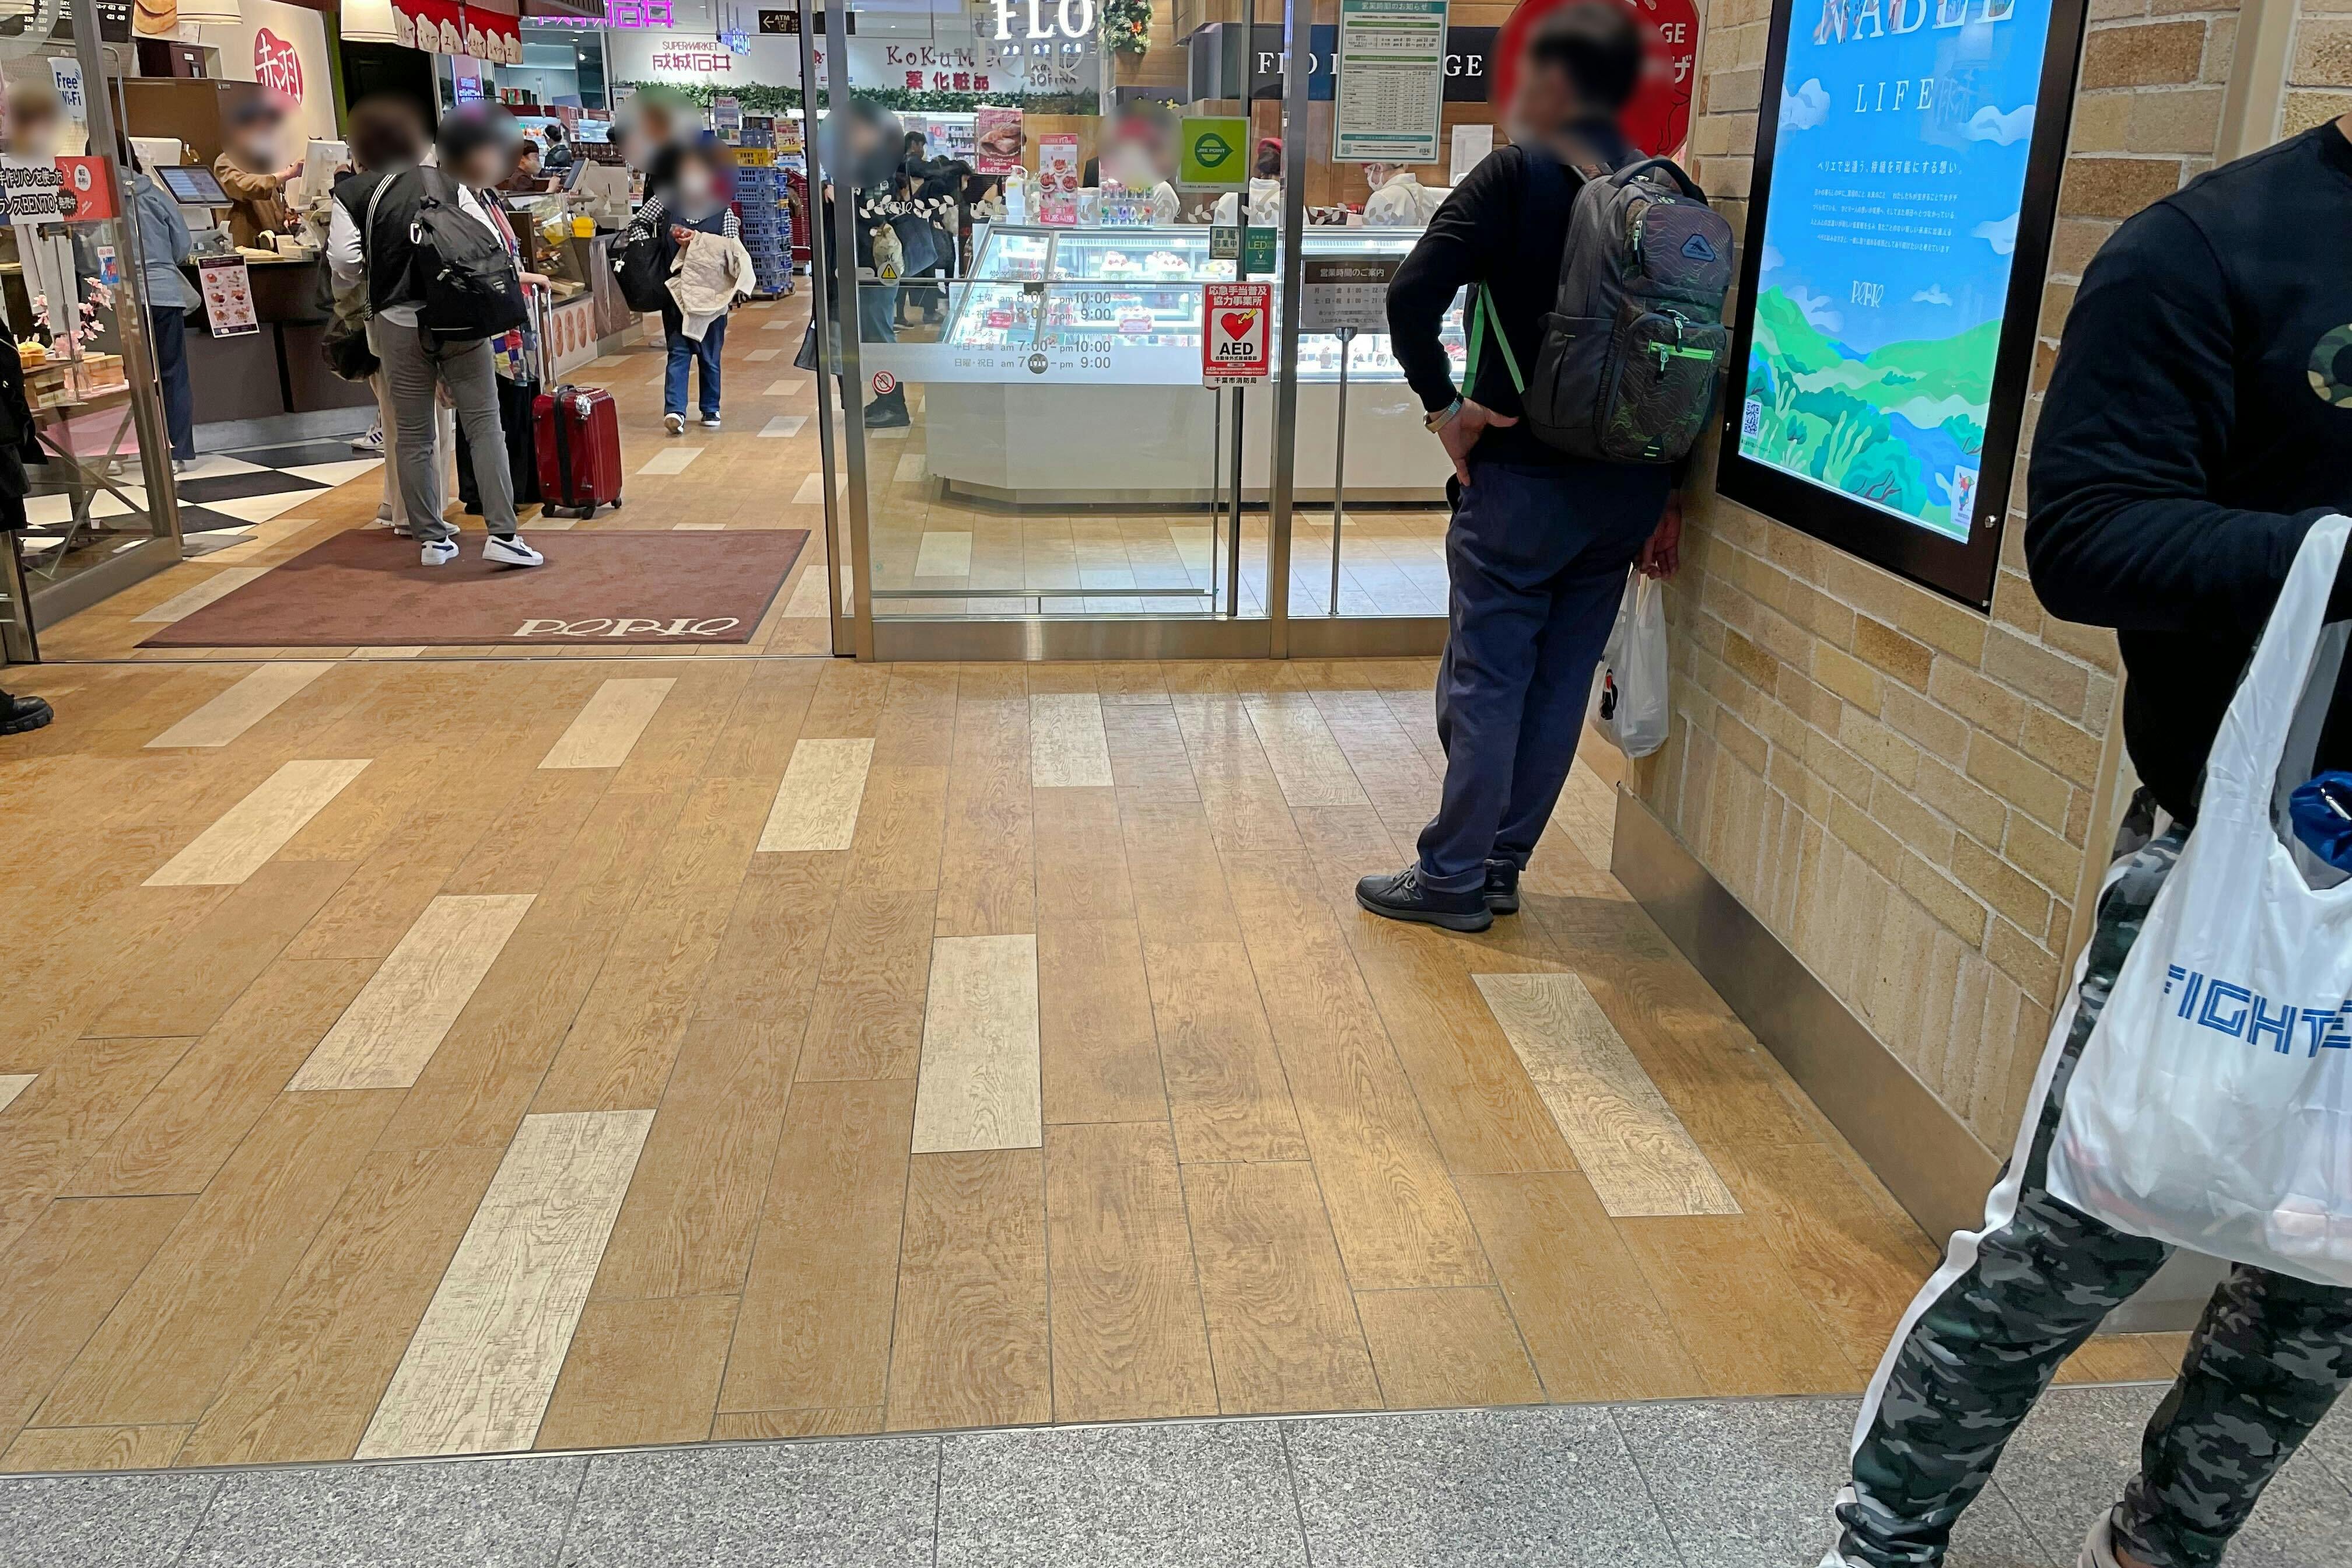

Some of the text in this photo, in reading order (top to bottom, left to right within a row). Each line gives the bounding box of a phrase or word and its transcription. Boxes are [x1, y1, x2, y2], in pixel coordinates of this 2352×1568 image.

[1362, 2, 1429, 11] 営業時間のお知らせ
[662, 41, 718, 51] SUPERMARKET
[255, 33, 302, 105] 赤羽
[652, 54, 732, 72] 成城石井
[55, 71, 78, 89] Free
[905, 71, 923, 90] 薬
[60, 90, 82, 106] Wi-Fi
[1854, 78, 1935, 113] LIFE
[59, 197, 76, 209] 発売中
[1248, 240, 1267, 250] LED
[989, 270, 1074, 279] 営業時間の案内
[1320, 268, 1385, 277] 営業時間のご案内
[1209, 285, 1268, 296] 応急手当普及
[953, 292, 993, 303] 平・土曜
[1017, 291, 1048, 303] 8:00
[1060, 296, 1073, 305] pm
[1075, 292, 1111, 304] 10:00
[1213, 296, 1262, 306] 協力事業所
[953, 310, 993, 320] 曜・祝日
[1017, 308, 1048, 320] 8:00
[1060, 313, 1073, 322] pm
[1081, 309, 1111, 320] 9:00
[954, 342, 994, 351] 平日・土曜
[1017, 341, 1048, 352] 7:00
[1060, 345, 1073, 353] pm
[1075, 341, 1111, 352] 10:00
[1219, 342, 1254, 355] AED
[954, 358, 994, 368] 日曜・祝日
[1060, 361, 1073, 369] pm
[1081, 357, 1111, 368] 9:00
